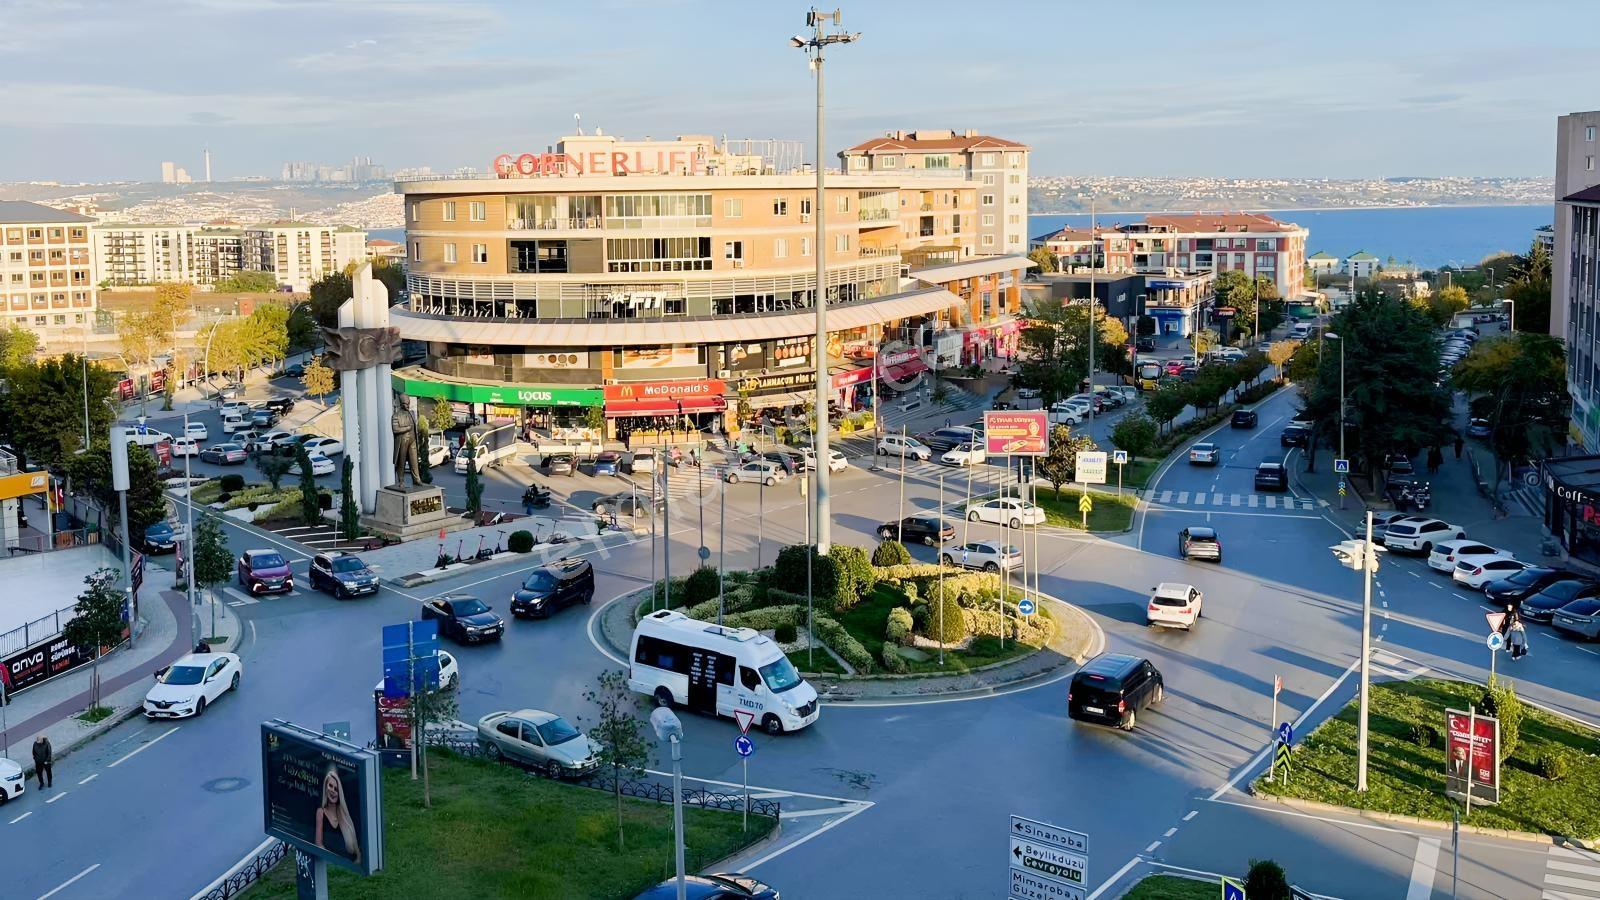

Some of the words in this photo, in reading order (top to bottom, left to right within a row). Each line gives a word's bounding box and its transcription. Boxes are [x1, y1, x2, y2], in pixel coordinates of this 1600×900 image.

[493, 151, 708, 177] CORNERLIFE
[518, 390, 552, 402] LOCUS
[644, 384, 709, 396] McDonald's
[1024, 825, 1083, 848] Sinanoba
[1013, 872, 1071, 898] Mimaroba
